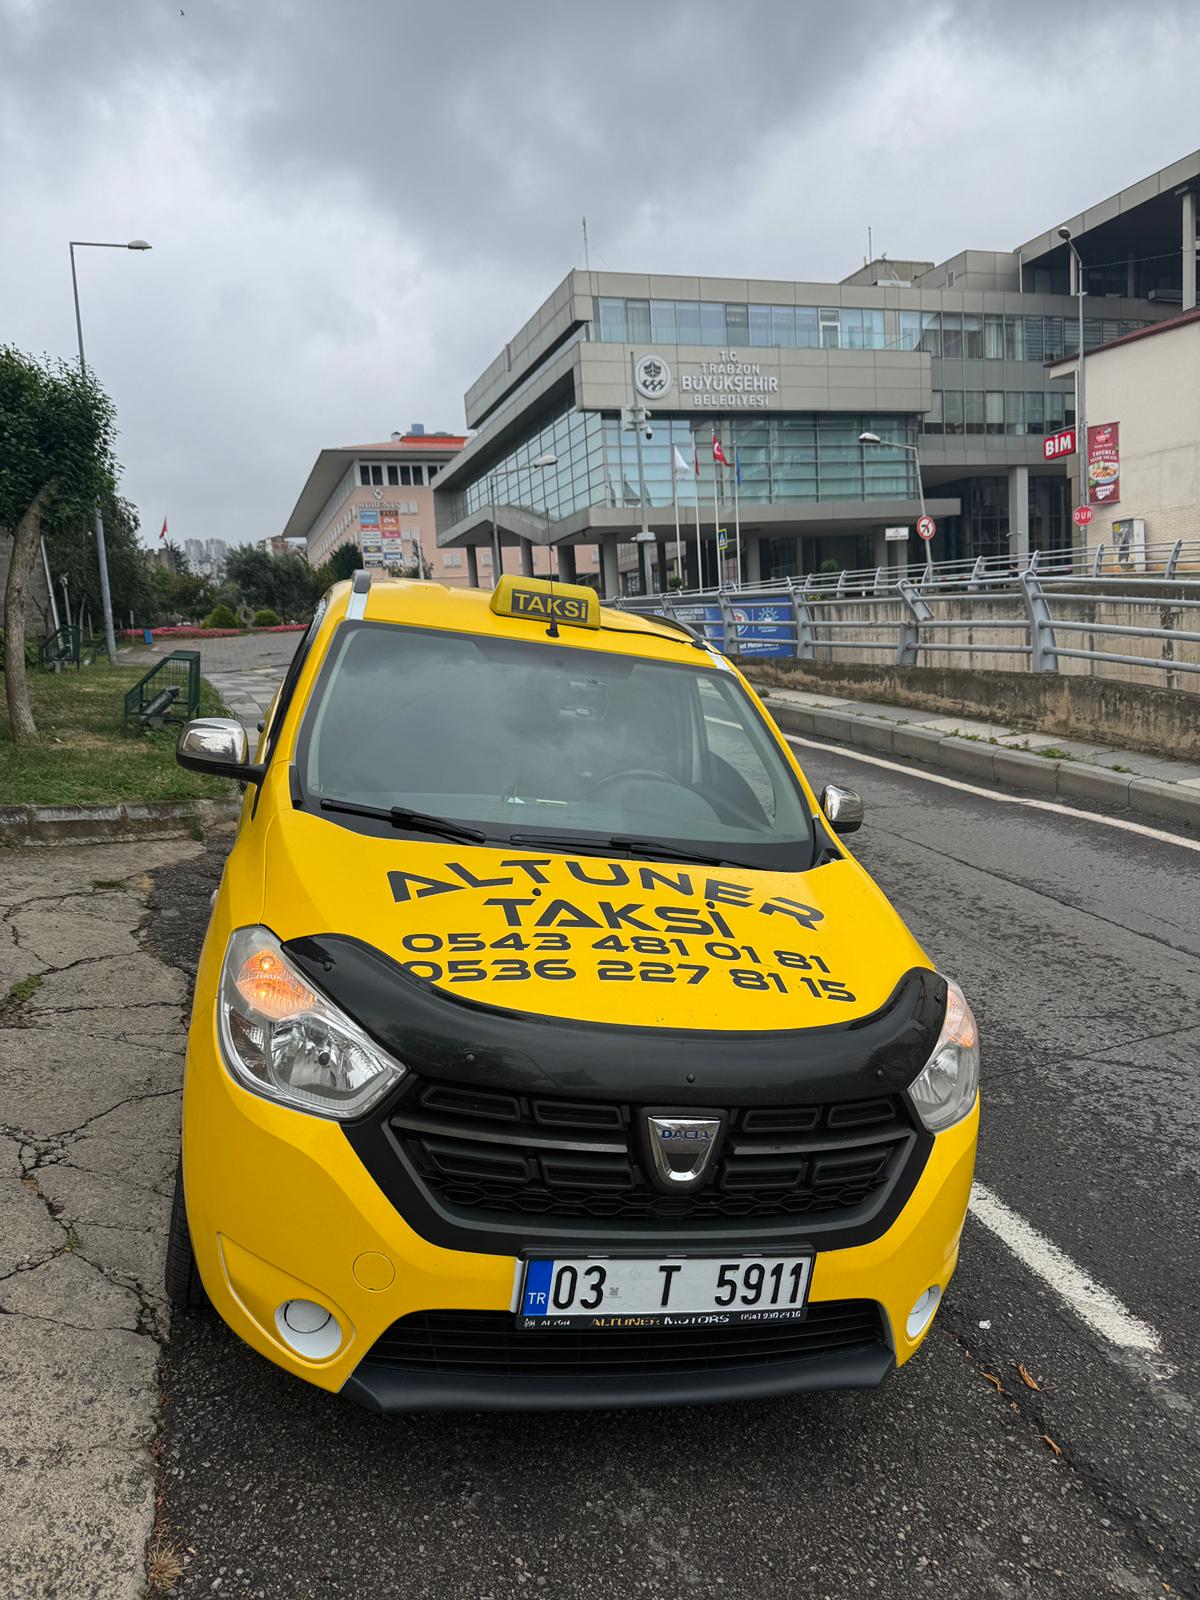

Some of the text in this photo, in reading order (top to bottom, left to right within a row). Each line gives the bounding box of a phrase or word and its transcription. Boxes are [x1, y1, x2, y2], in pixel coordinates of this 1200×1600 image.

[719, 352, 740, 362] T.C.
[701, 363, 760, 375] TRABZON
[682, 376, 778, 392] BÜYÜKŞEHİR
[694, 394, 769, 406] BELEDİYESİ
[1045, 434, 1072, 457] BİM
[1075, 511, 1093, 521] DUR
[514, 593, 587, 619] TAKSİ
[386, 859, 825, 930] ALTUNER
[483, 898, 735, 939] TAKSİ
[402, 932, 832, 974] 0543 481 01 81
[402, 959, 857, 1003] 0536 227 81 15
[661, 1129, 711, 1140] DACIA
[552, 1262, 804, 1310] 03 T 5911
[528, 1292, 547, 1305] TR
[664, 1314, 730, 1325] MOTORS
